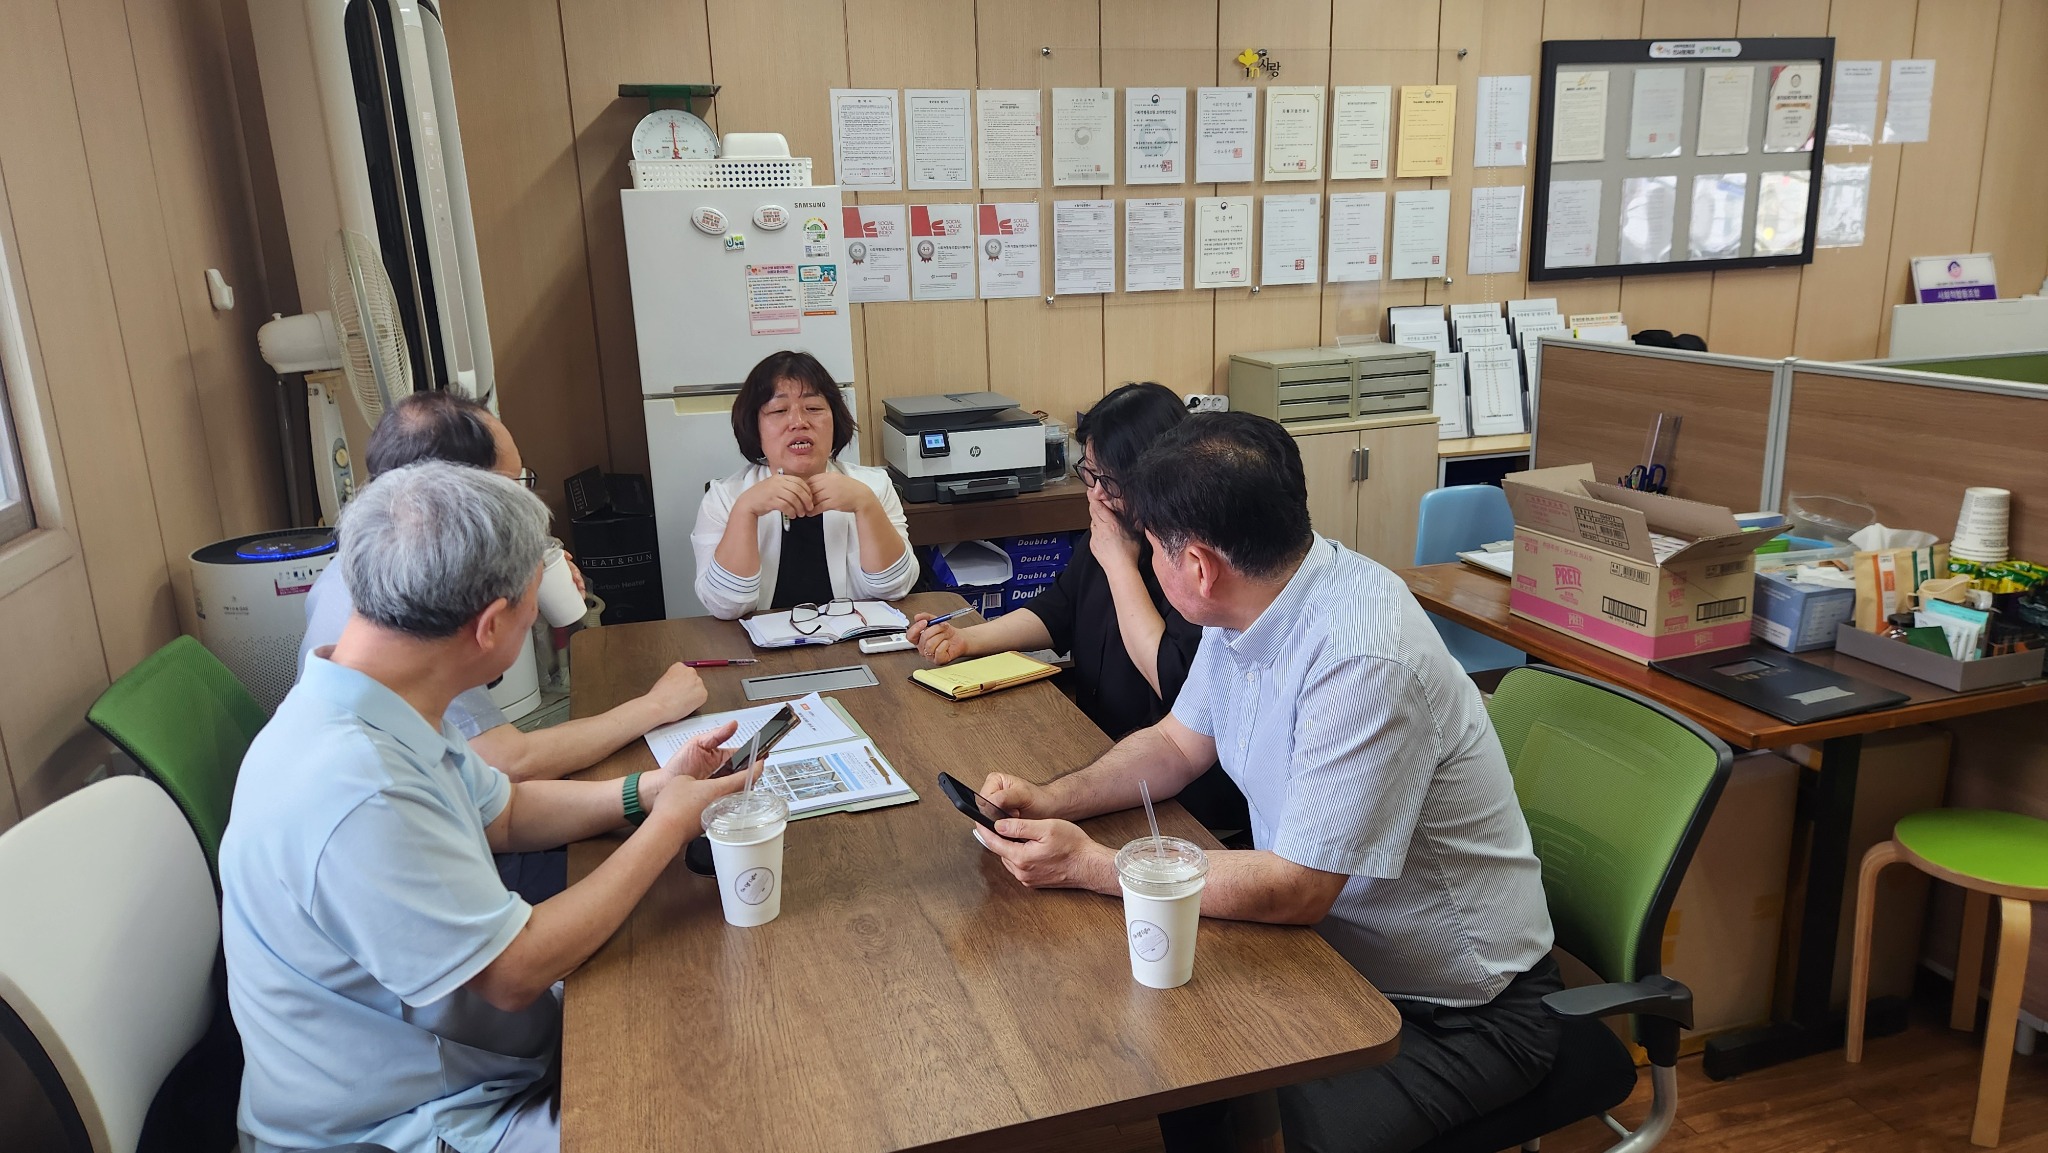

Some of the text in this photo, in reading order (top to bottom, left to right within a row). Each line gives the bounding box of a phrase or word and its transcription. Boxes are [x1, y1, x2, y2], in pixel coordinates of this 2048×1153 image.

[970, 446, 982, 457] hp
[1017, 538, 1048, 546] Double
[581, 553, 652, 567] HEAT&RUN
[1020, 554, 1051, 563] Double
[1016, 572, 1047, 581] Double
[1554, 566, 1582, 587] PRETZ
[622, 578, 645, 588] Heater
